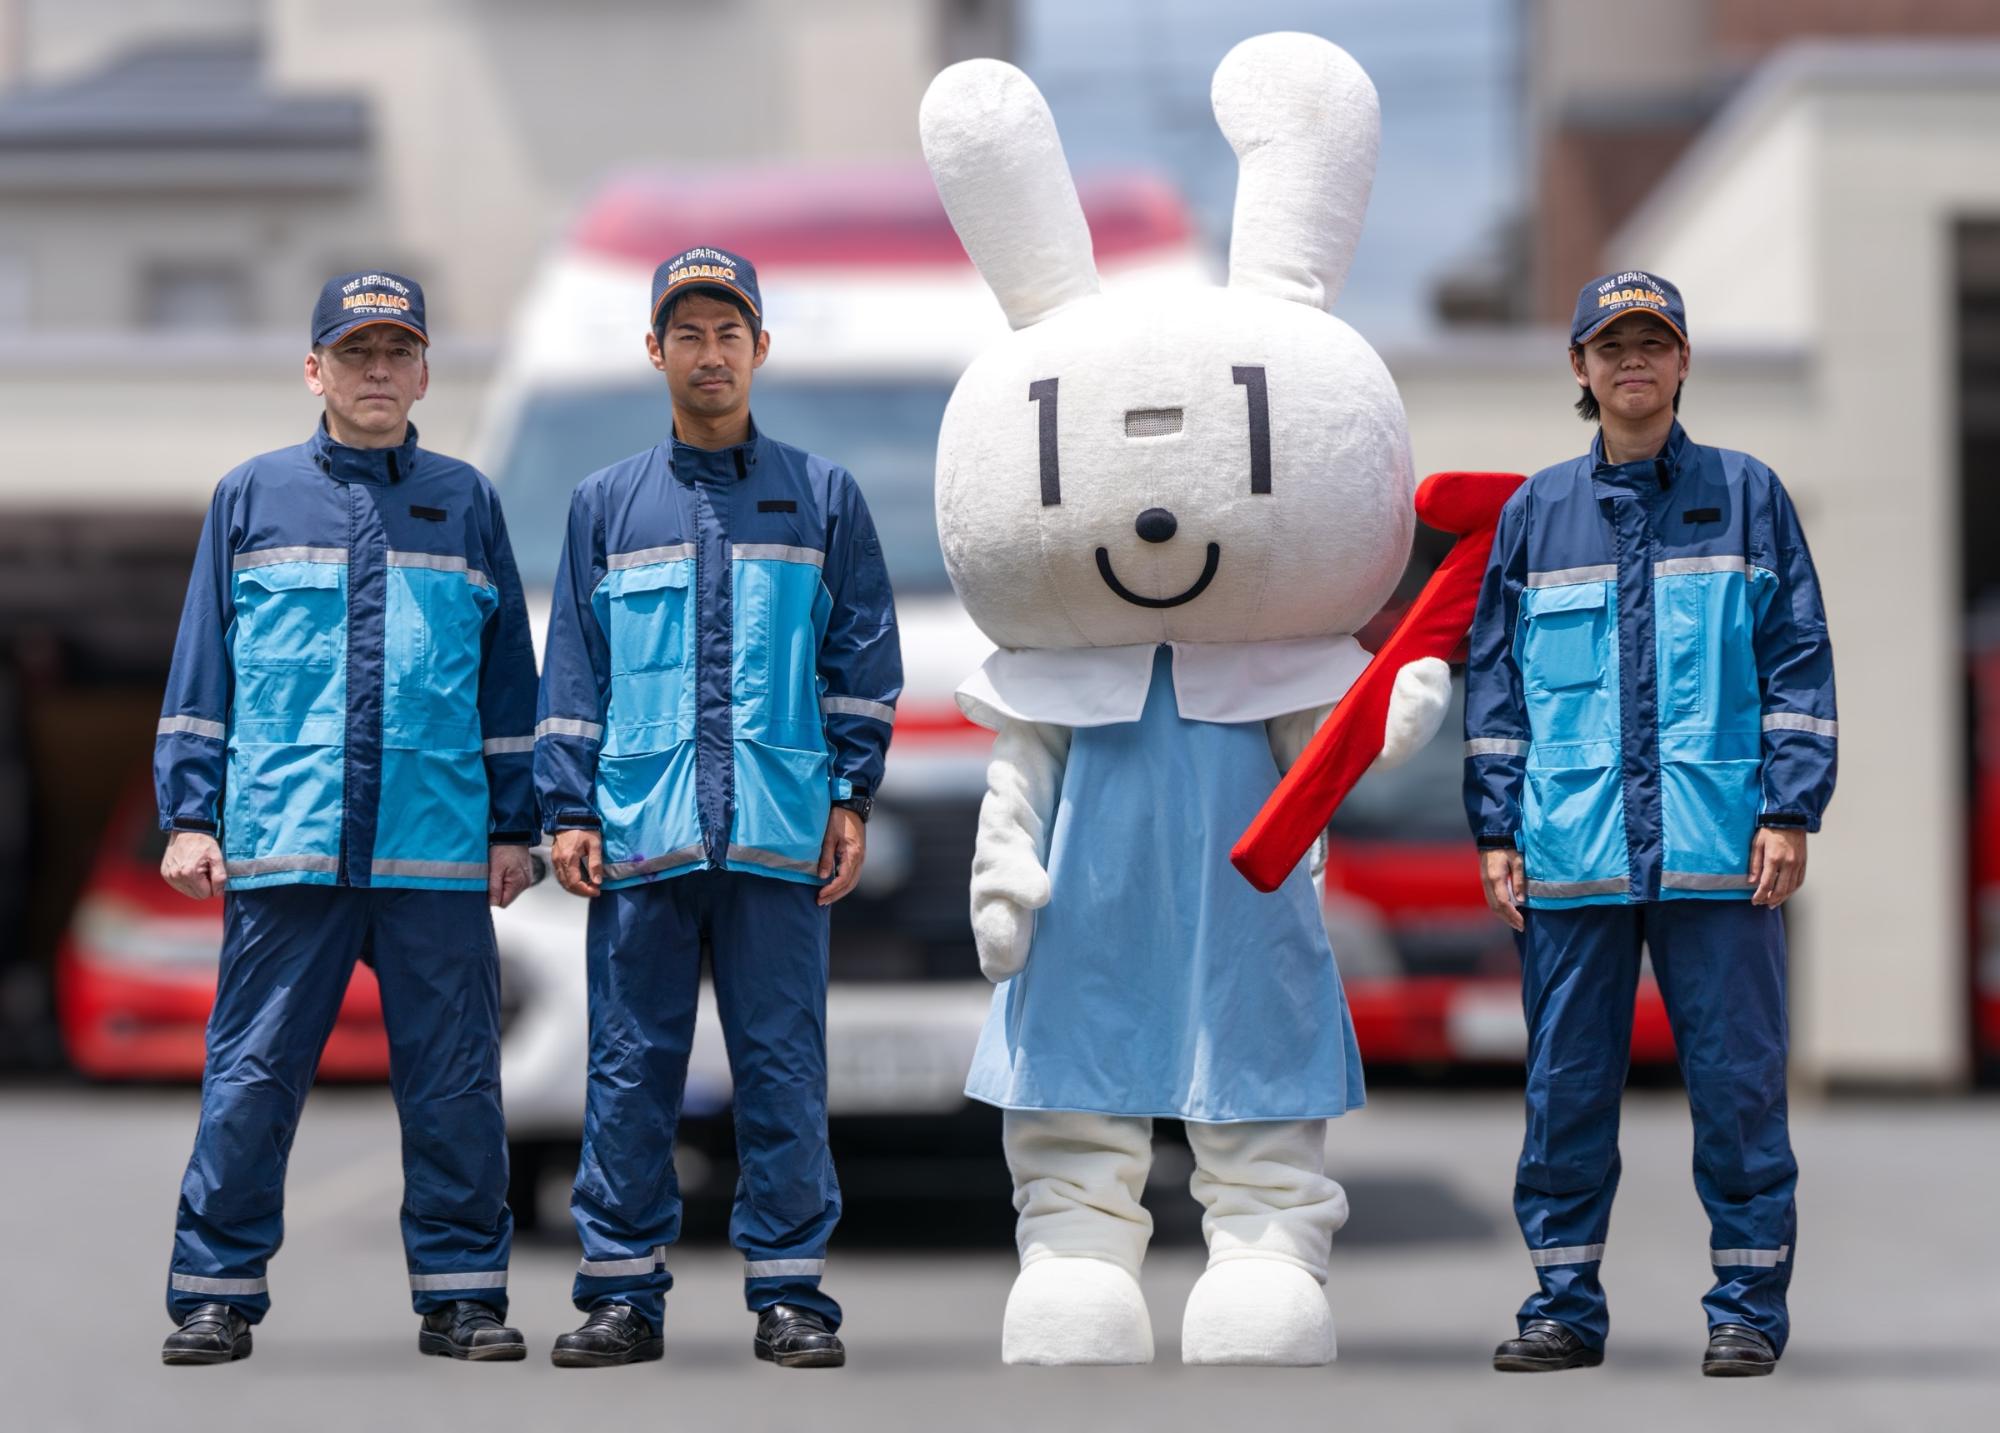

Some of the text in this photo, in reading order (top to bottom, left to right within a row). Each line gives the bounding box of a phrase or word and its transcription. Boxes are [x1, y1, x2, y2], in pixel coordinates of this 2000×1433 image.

[668, 248, 737, 272] FIRE DEPARTMENT
[342, 274, 410, 296] FIRE DEPARTMENT
[668, 264, 736, 285] HADANO
[1598, 272, 1665, 295] FIRE DEPARTMENT
[342, 292, 410, 311] HADANO
[1598, 288, 1668, 308] HADANO
